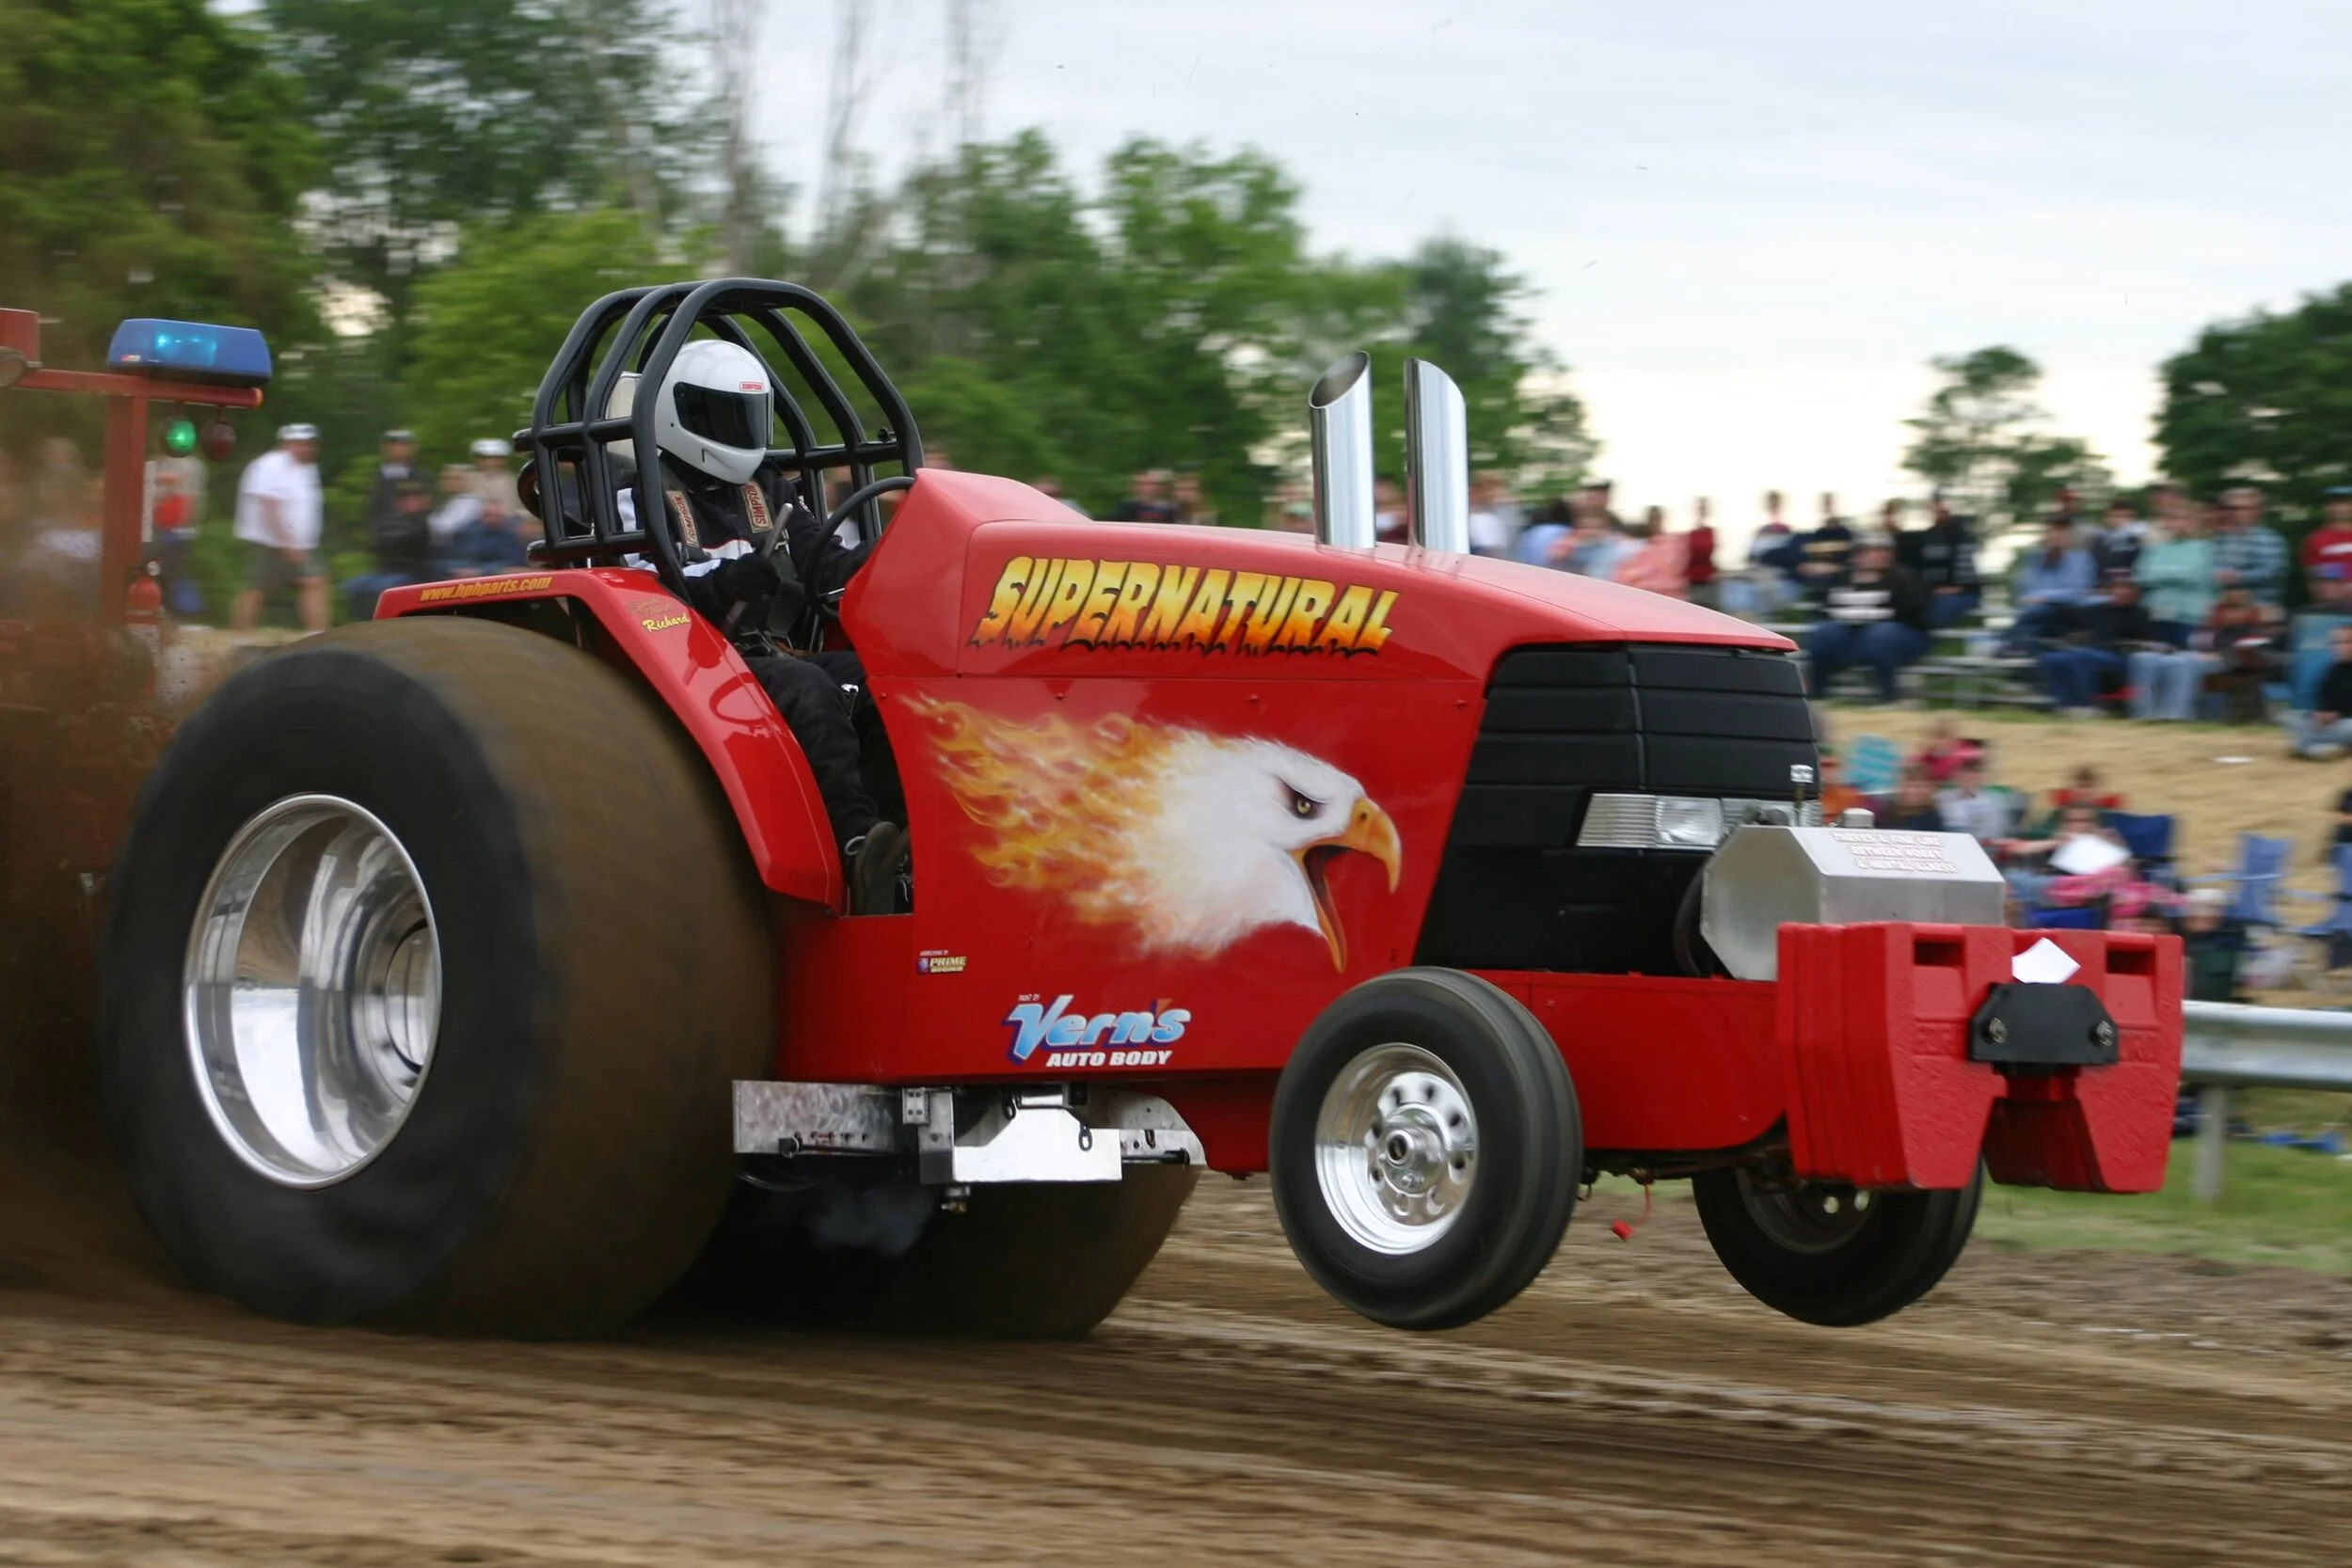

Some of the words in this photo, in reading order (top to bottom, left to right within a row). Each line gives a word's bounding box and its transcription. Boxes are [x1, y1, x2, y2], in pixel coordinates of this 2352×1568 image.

[965, 556, 1401, 657] SUPERNATURAL
[642, 612, 691, 633] Richard
[930, 956, 967, 967] PRIME
[1002, 994, 1192, 1064] Vern's
[1045, 1052, 1106, 1068] AUTO
[1108, 1050, 1173, 1067] BODY
